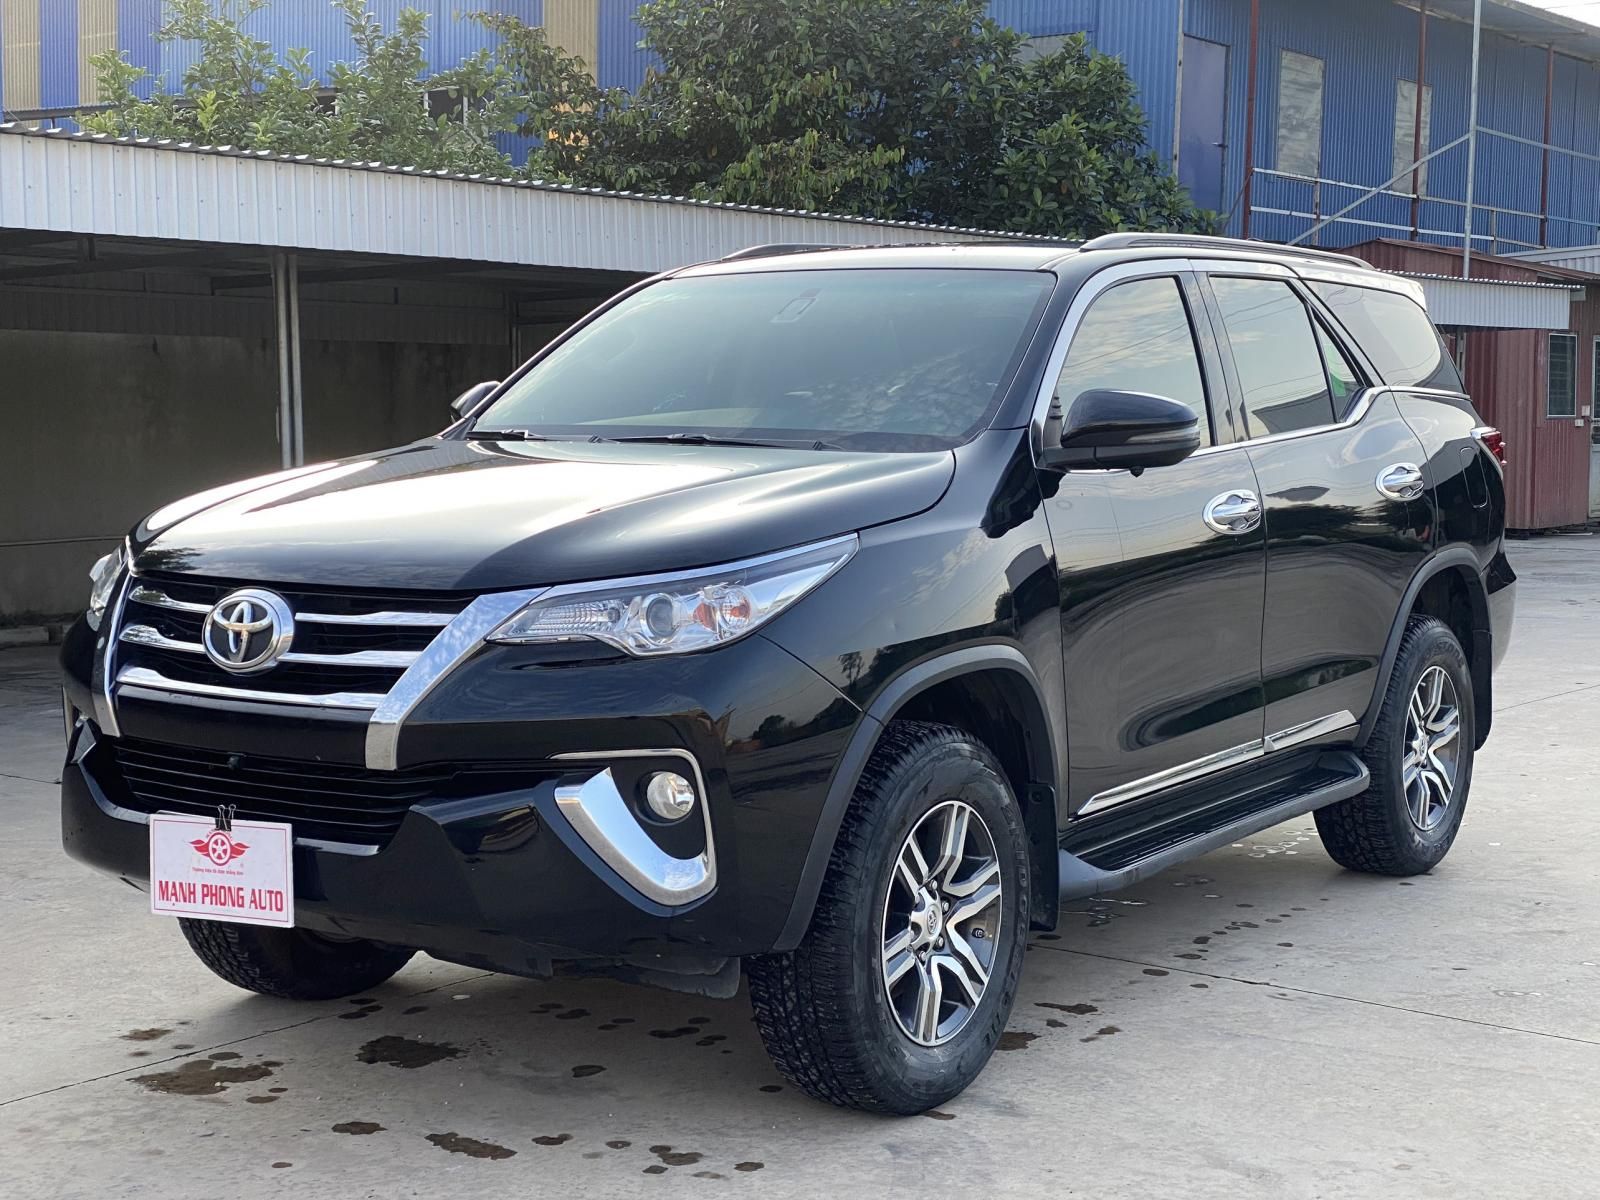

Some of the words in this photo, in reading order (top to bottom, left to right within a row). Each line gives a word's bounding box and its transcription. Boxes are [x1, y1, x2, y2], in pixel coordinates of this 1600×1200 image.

[158, 880, 197, 906] MẠNH
[201, 883, 245, 908] PHONG
[249, 888, 284, 912] AUTO
